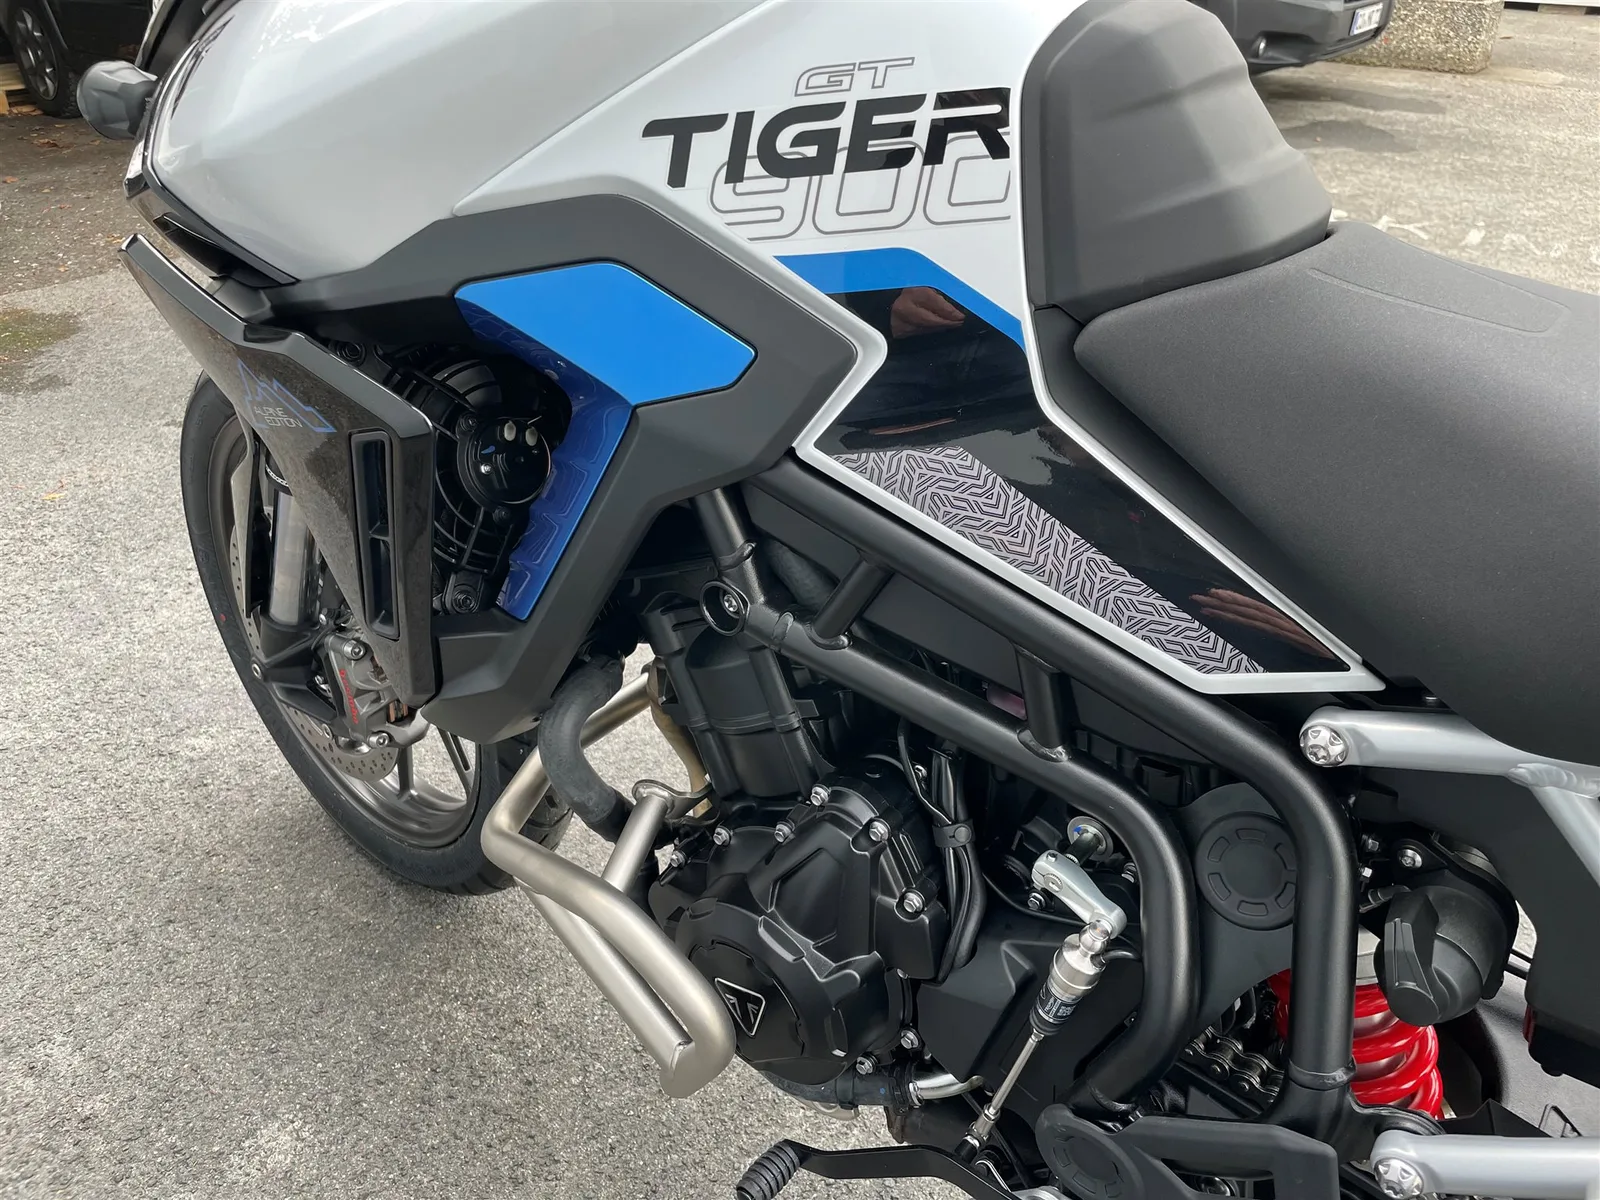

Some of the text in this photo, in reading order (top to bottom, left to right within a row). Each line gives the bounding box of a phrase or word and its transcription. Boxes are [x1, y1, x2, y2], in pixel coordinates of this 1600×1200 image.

[794, 57, 915, 97] GT
[642, 87, 1011, 188] TIGER
[709, 131, 1011, 241] 900
